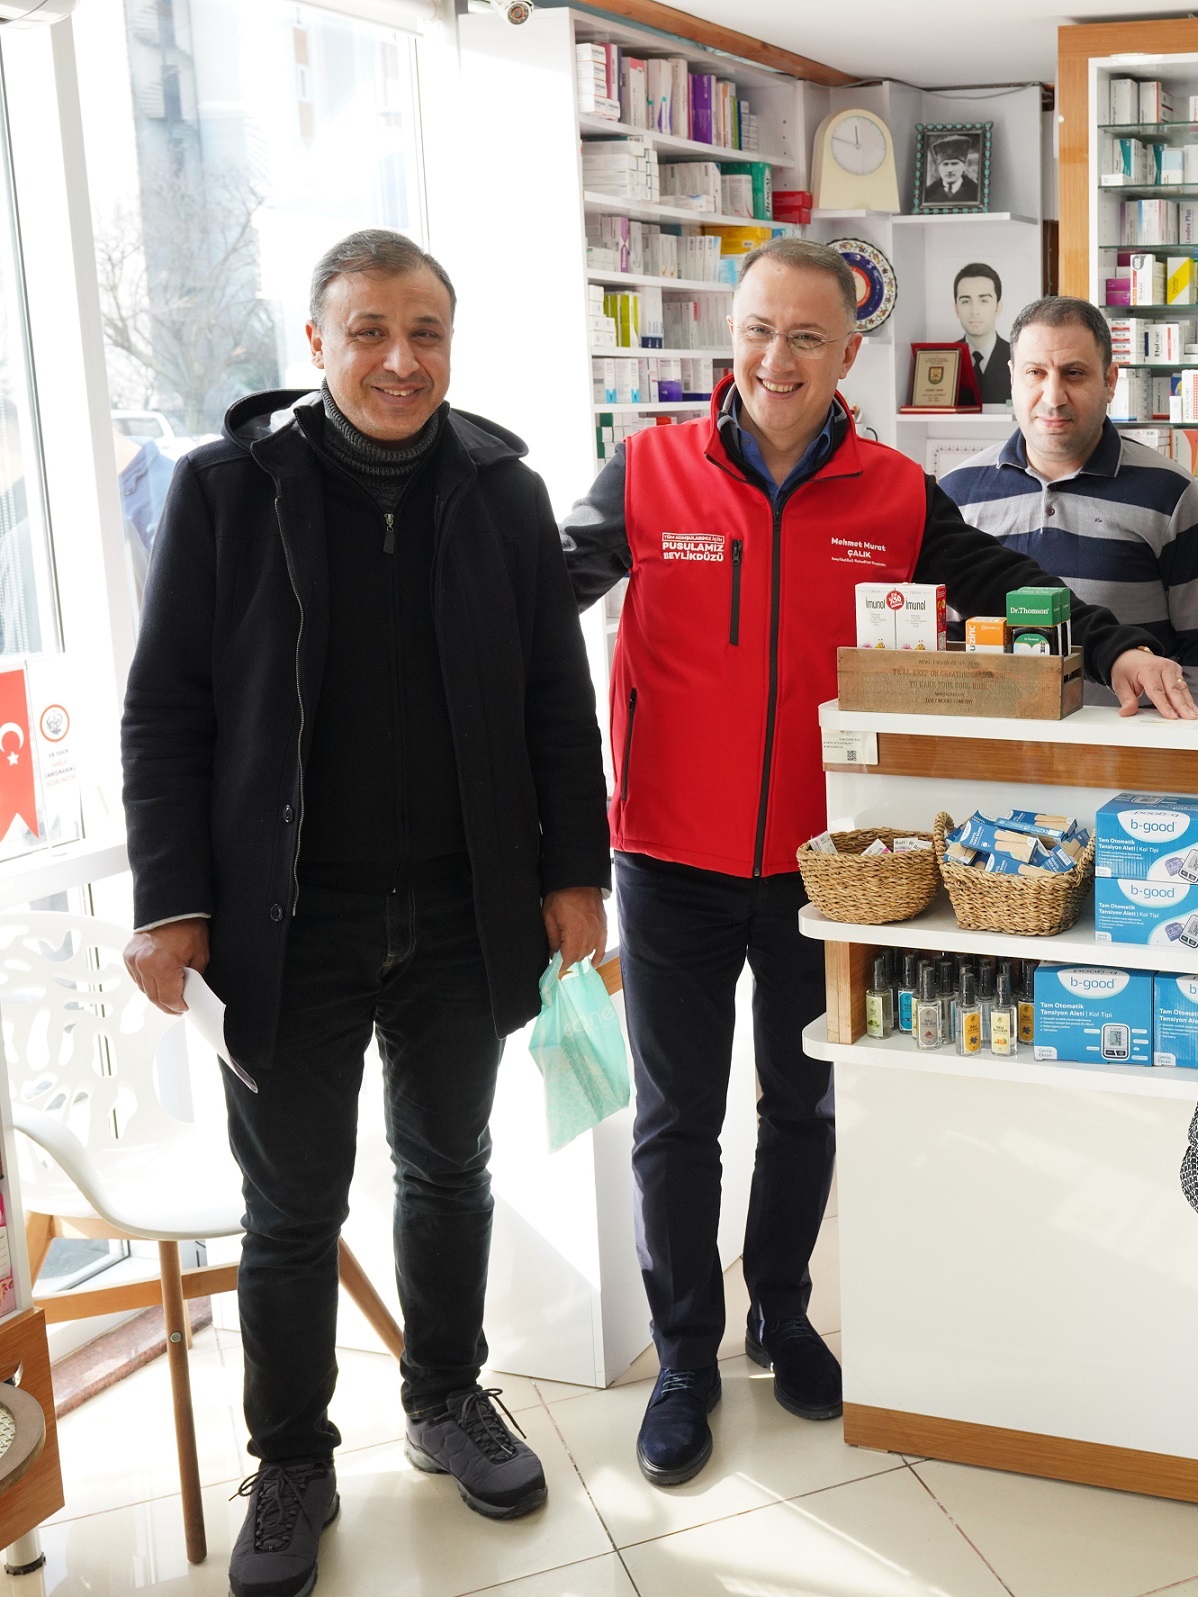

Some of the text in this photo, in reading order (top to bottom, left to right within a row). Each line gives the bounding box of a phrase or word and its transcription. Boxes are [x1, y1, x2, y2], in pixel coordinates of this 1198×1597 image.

[662, 542, 724, 552] PUSULAMIZ
[831, 537, 886, 552] Mehmet Murat
[663, 550, 724, 562] BEYLİKDÜZÜ
[847, 549, 871, 558] ÇALIK
[1010, 607, 1049, 615] Dr.Thomson
[1130, 819, 1175, 833] b-good
[1130, 885, 1175, 898] b-good
[1070, 977, 1115, 990] b-good
[1040, 1009, 1069, 1017] Tansiyon
[1159, 1016, 1187, 1024] Tansiyon
